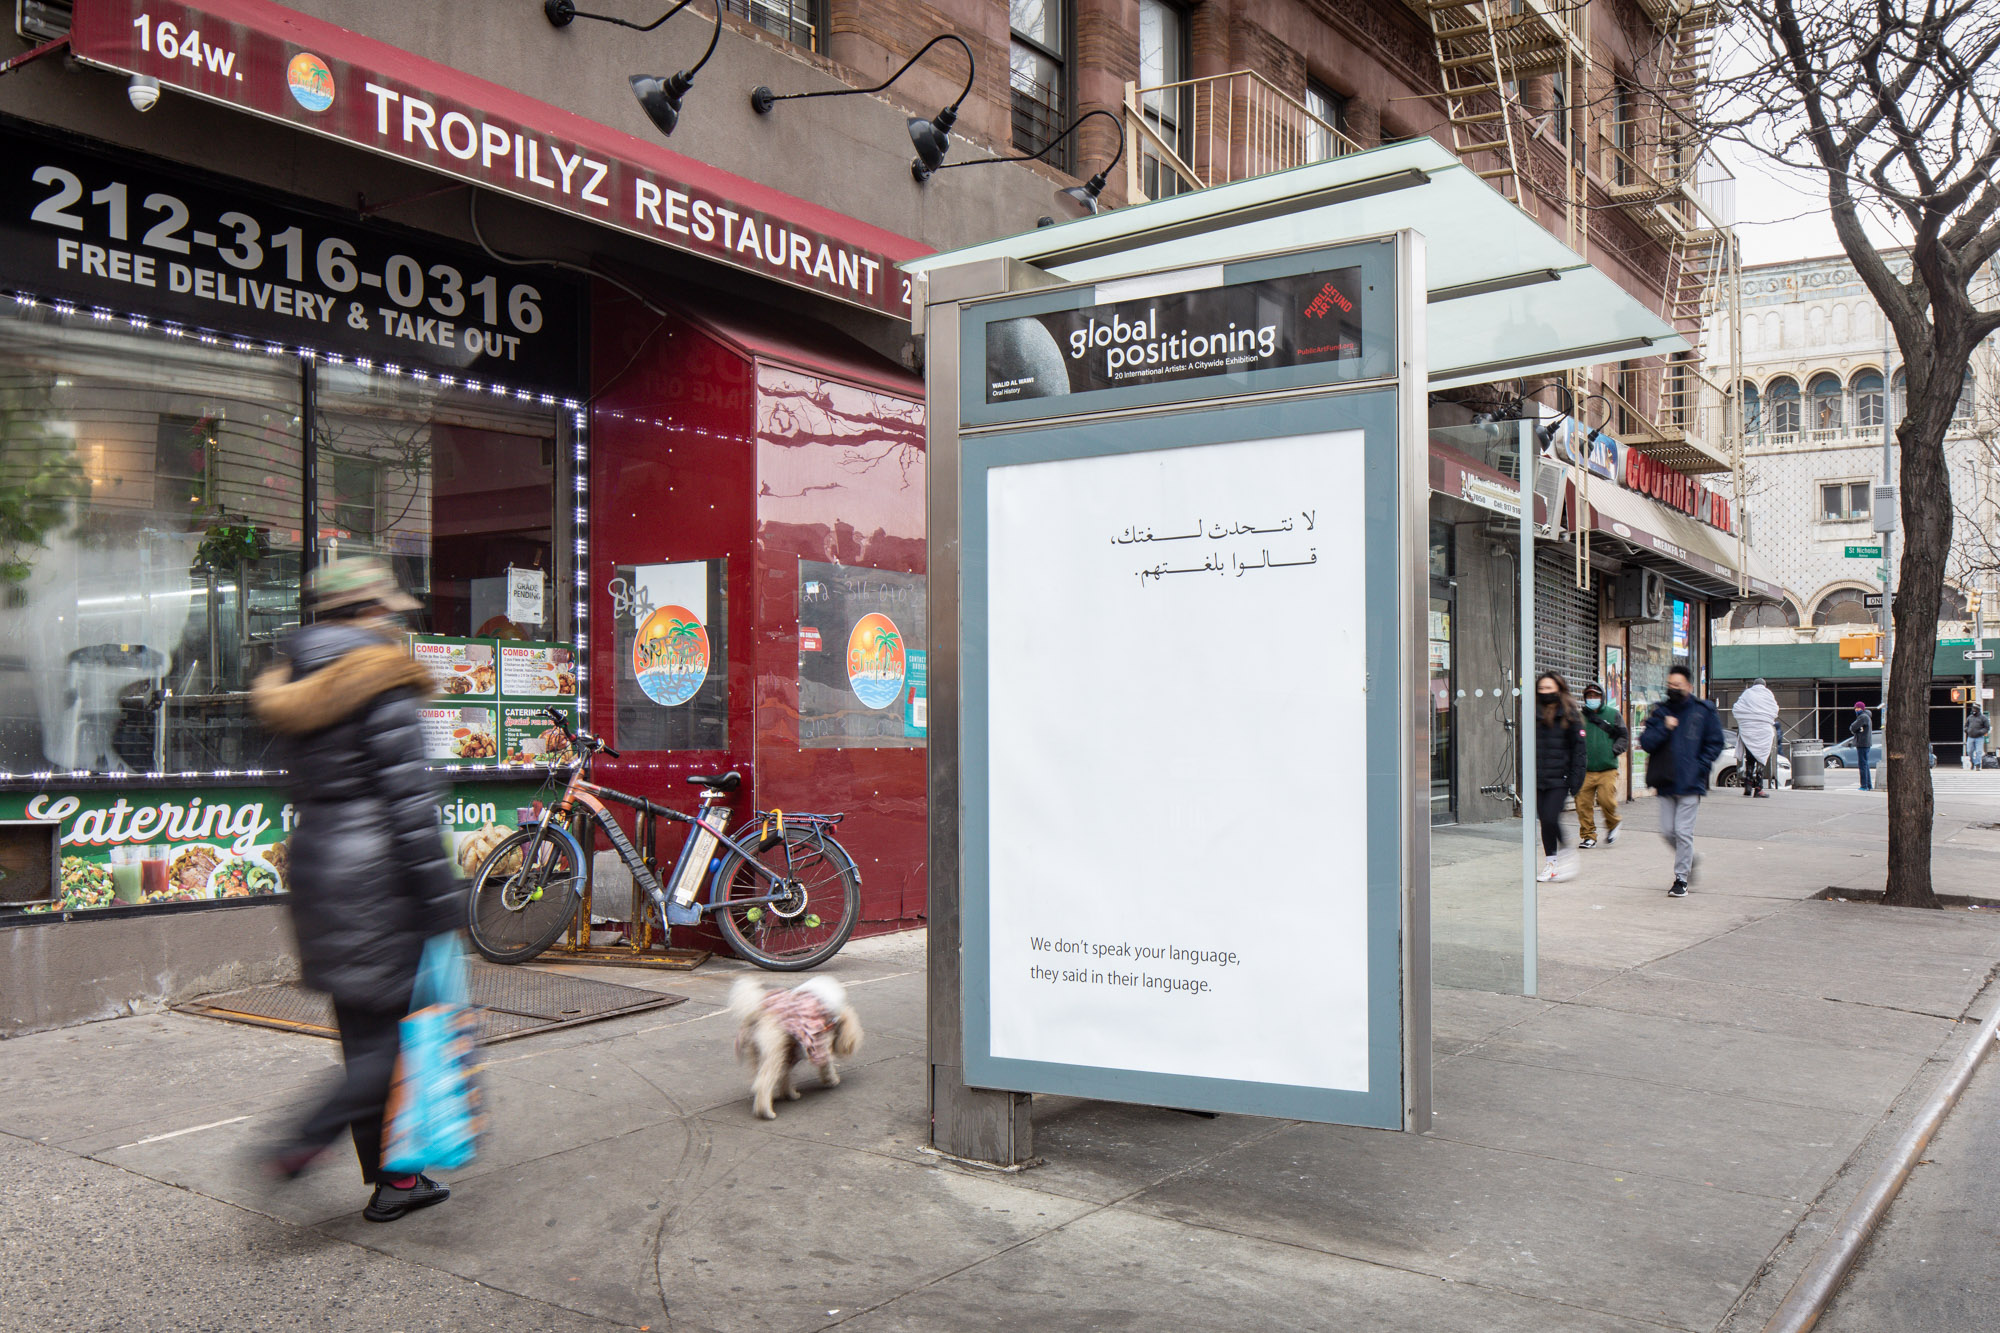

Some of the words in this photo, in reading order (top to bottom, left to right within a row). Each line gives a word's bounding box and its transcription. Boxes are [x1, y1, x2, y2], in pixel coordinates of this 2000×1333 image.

[366, 82, 609, 206] TROPILYZ
[636, 178, 879, 295] RESTAURANT
[30, 165, 543, 334] 212-316-0316
[58, 238, 156, 287] FREE
[169, 263, 336, 322] DELIVERY
[347, 302, 370, 330] &
[378, 308, 455, 348] TAKE
[464, 328, 521, 361] OUT
[1304, 282, 1334, 319] PUBLIC
[1316, 294, 1334, 319] ART
[1330, 288, 1353, 313] FUND
[1069, 308, 1156, 359] global
[1107, 322, 1276, 378] positioning
[1297, 342, 1354, 356] PublicArtFund.org
[1114, 372, 1124, 380] 20
[1124, 367, 1164, 379] International
[1164, 364, 1188, 374] Artists:
[1194, 359, 1224, 370] Citywide
[1225, 354, 1259, 366] Exhibition
[992, 380, 1010, 389] WALID
[1010, 379, 1018, 387] AL
[992, 389, 1003, 397] Oral
[1004, 387, 1020, 396] History
[1626, 447, 1700, 518] GOURMET
[1302, 509, 1316, 531] لا
[1857, 546, 1878, 554] Nicholas
[513, 590, 541, 600] PENDING
[516, 582, 539, 592] GRADE
[416, 645, 444, 654] COMBO
[446, 646, 451, 654] 8
[503, 648, 528, 657] COMBO
[416, 710, 445, 718] COMBO
[447, 710, 455, 718] 11
[505, 708, 541, 717] CATERING
[25, 794, 272, 856] Catering
[434, 798, 496, 827] sion
[1030, 936, 1051, 951] We
[1054, 938, 1088, 954] don’t
[1092, 942, 1131, 959] speak
[1134, 946, 1166, 961] your
[1169, 944, 1240, 966] language,
[1030, 964, 1059, 984] they
[1062, 968, 1087, 982] said
[1091, 969, 1103, 984] in
[1107, 970, 1139, 986] their
[1142, 972, 1212, 995] language.
